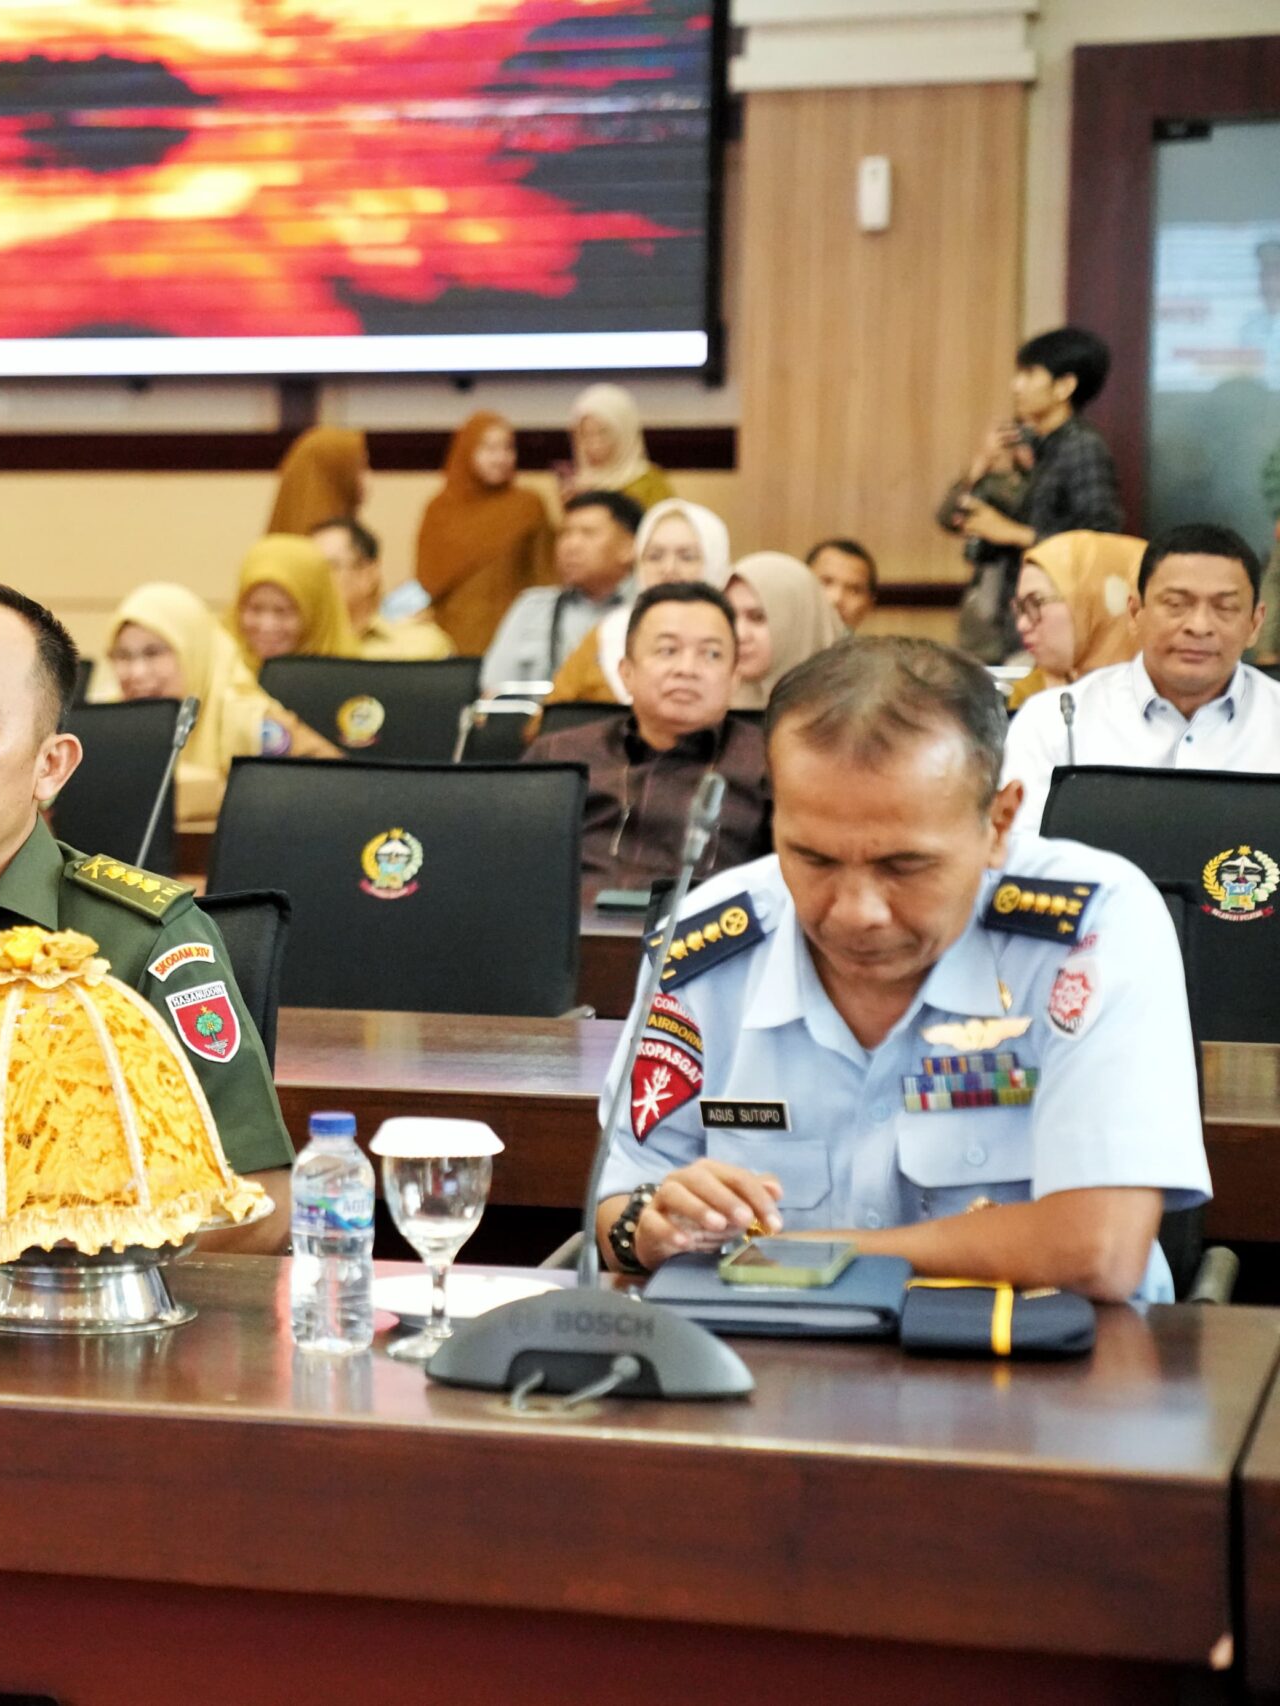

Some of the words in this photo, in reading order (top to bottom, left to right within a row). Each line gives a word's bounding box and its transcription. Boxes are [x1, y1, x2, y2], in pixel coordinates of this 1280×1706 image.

[648, 1013, 704, 1051] AIRBORN
[708, 1107, 735, 1122] AGUS
[739, 1108, 780, 1123] SUTOPO
[554, 1309, 656, 1338] BOSCH
